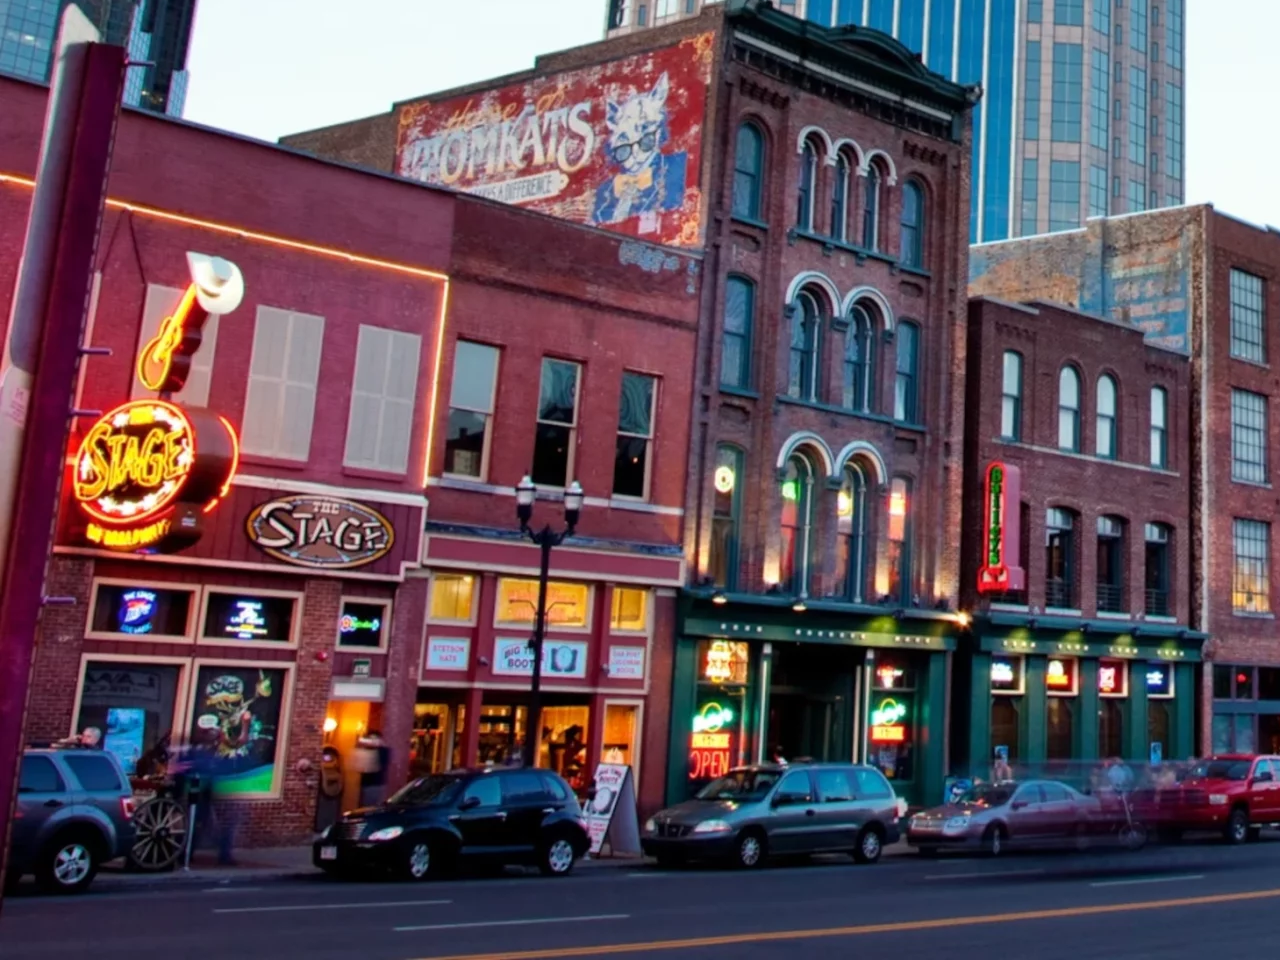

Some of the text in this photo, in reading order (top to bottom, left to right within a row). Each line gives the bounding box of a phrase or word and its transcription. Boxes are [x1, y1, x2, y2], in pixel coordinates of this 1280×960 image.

[410, 101, 595, 184] TOMKATS
[78, 422, 186, 500] STAGE
[254, 502, 386, 552] STAGE
[504, 646, 521, 660] BIG
[508, 657, 542, 669] BOOT
[689, 750, 730, 779] OPEN
